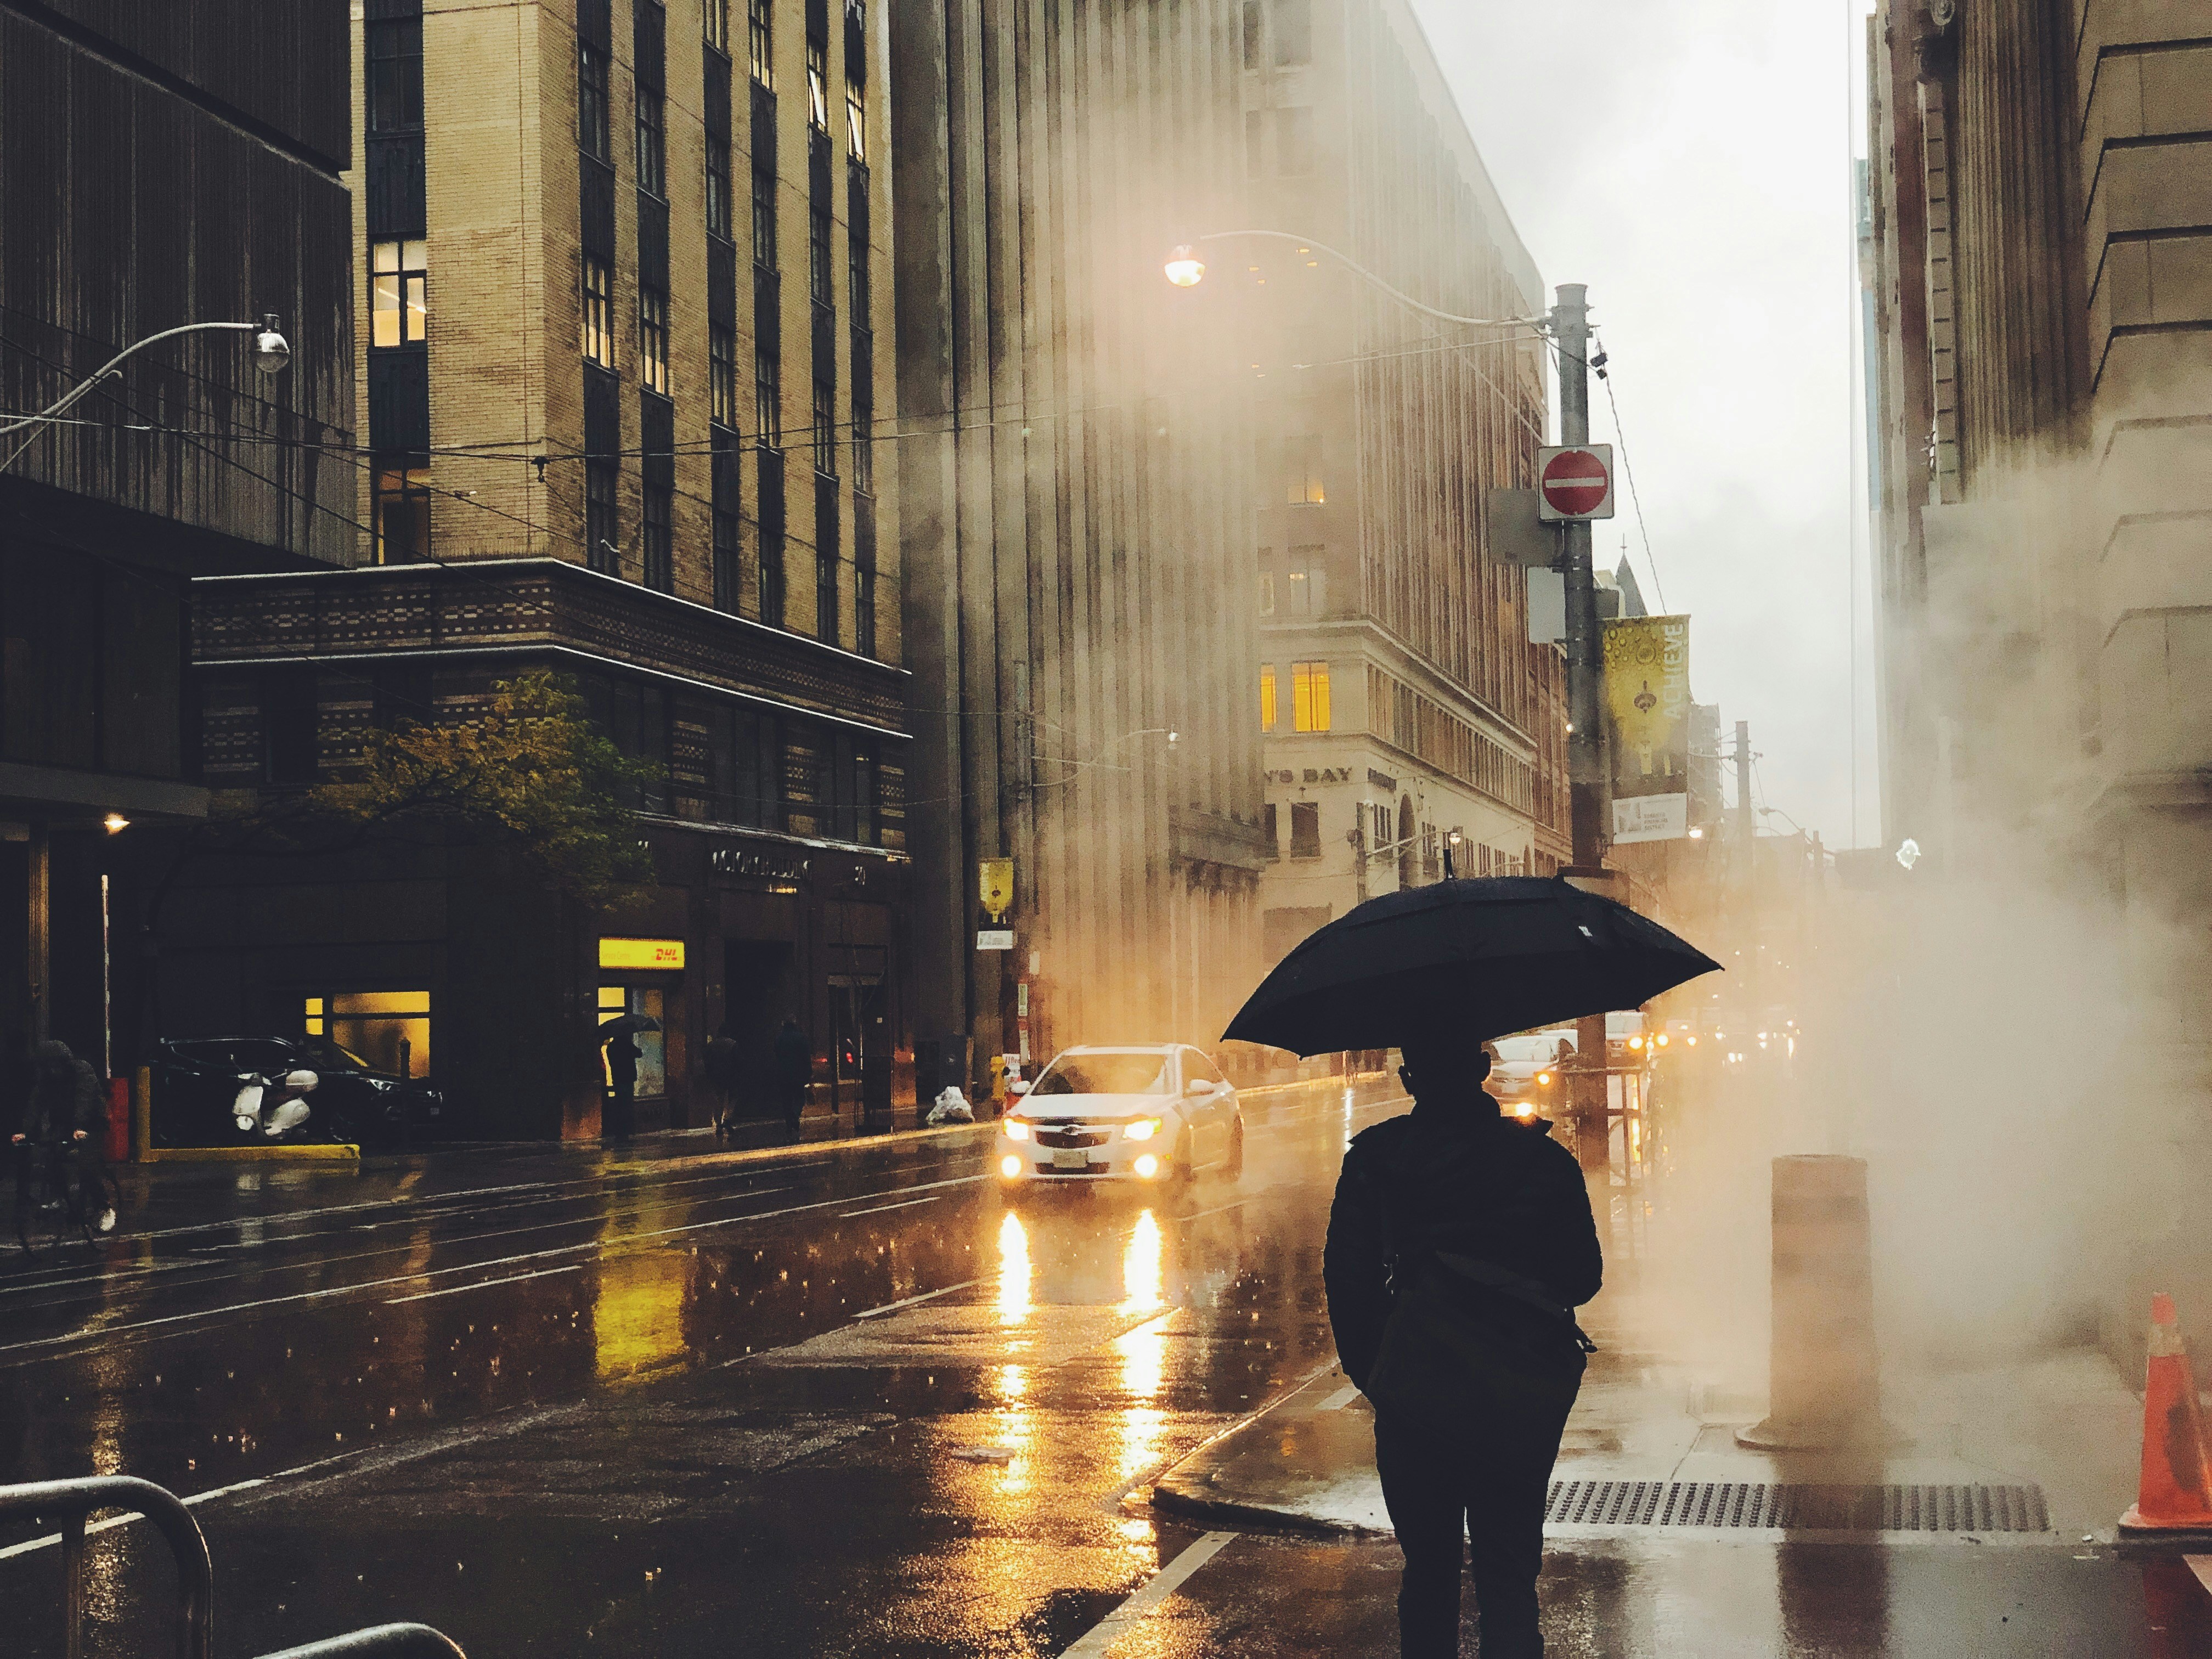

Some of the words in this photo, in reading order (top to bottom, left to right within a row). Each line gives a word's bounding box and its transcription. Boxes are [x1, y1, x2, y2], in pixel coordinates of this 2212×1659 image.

[1664, 623, 1684, 719] ACHIEVE
[1303, 767, 1352, 782] BAY
[656, 949, 678, 961] DHL
